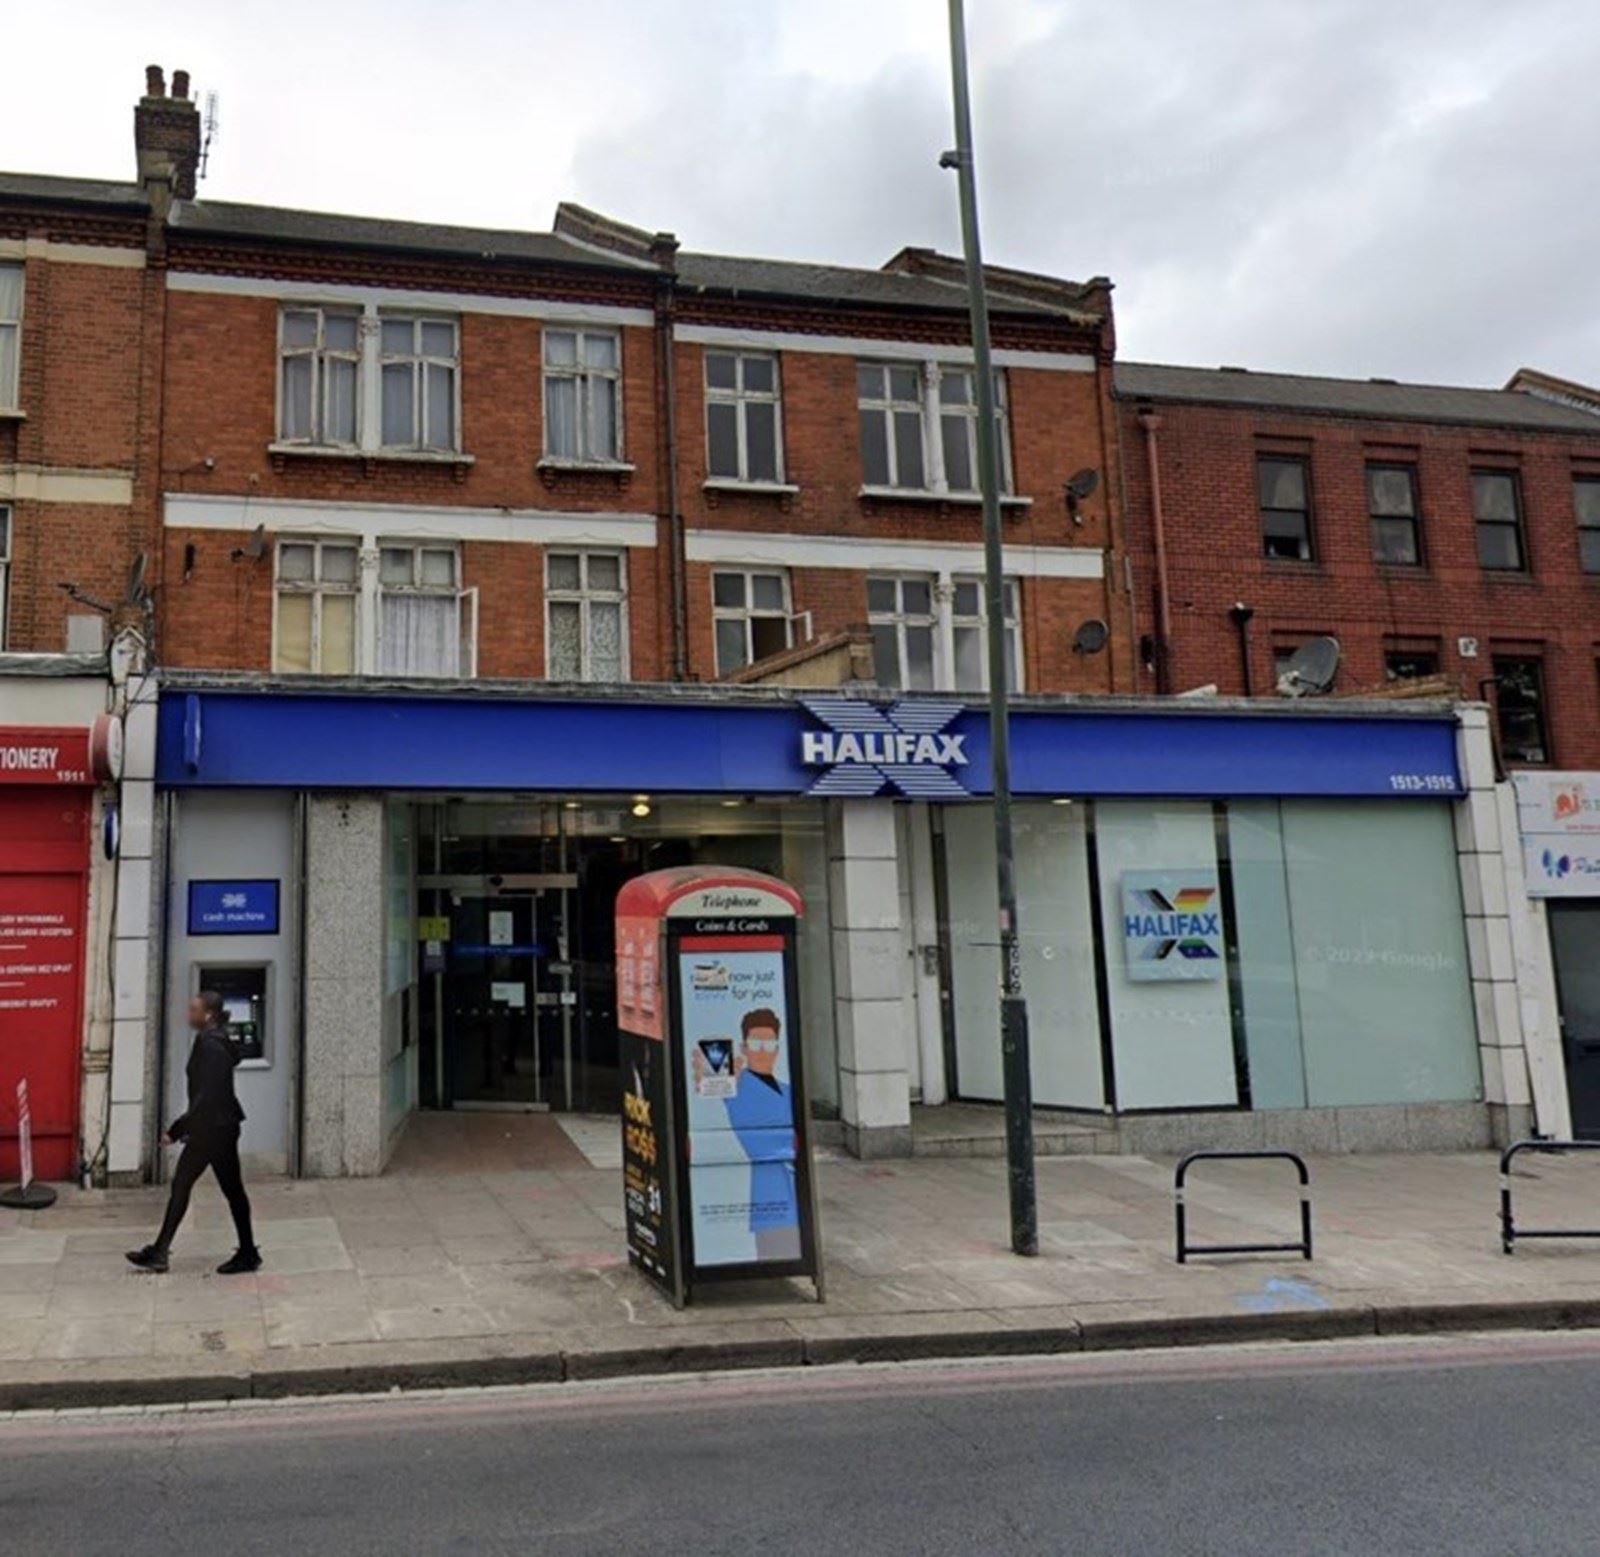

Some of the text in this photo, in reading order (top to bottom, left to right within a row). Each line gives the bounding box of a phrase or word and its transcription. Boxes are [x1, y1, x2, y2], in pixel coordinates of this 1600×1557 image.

[802, 732, 968, 764] HALIFAX
[0, 747, 58, 769] IONERY
[1390, 775, 1455, 790] 1513-1515
[703, 895, 762, 910] Telephone
[696, 920, 724, 932] Coins
[738, 920, 769, 932] Cards
[1125, 914, 1219, 937] HALIFAX
[729, 970, 775, 985] now just
[731, 985, 748, 1000] for
[752, 988, 773, 1002] you
